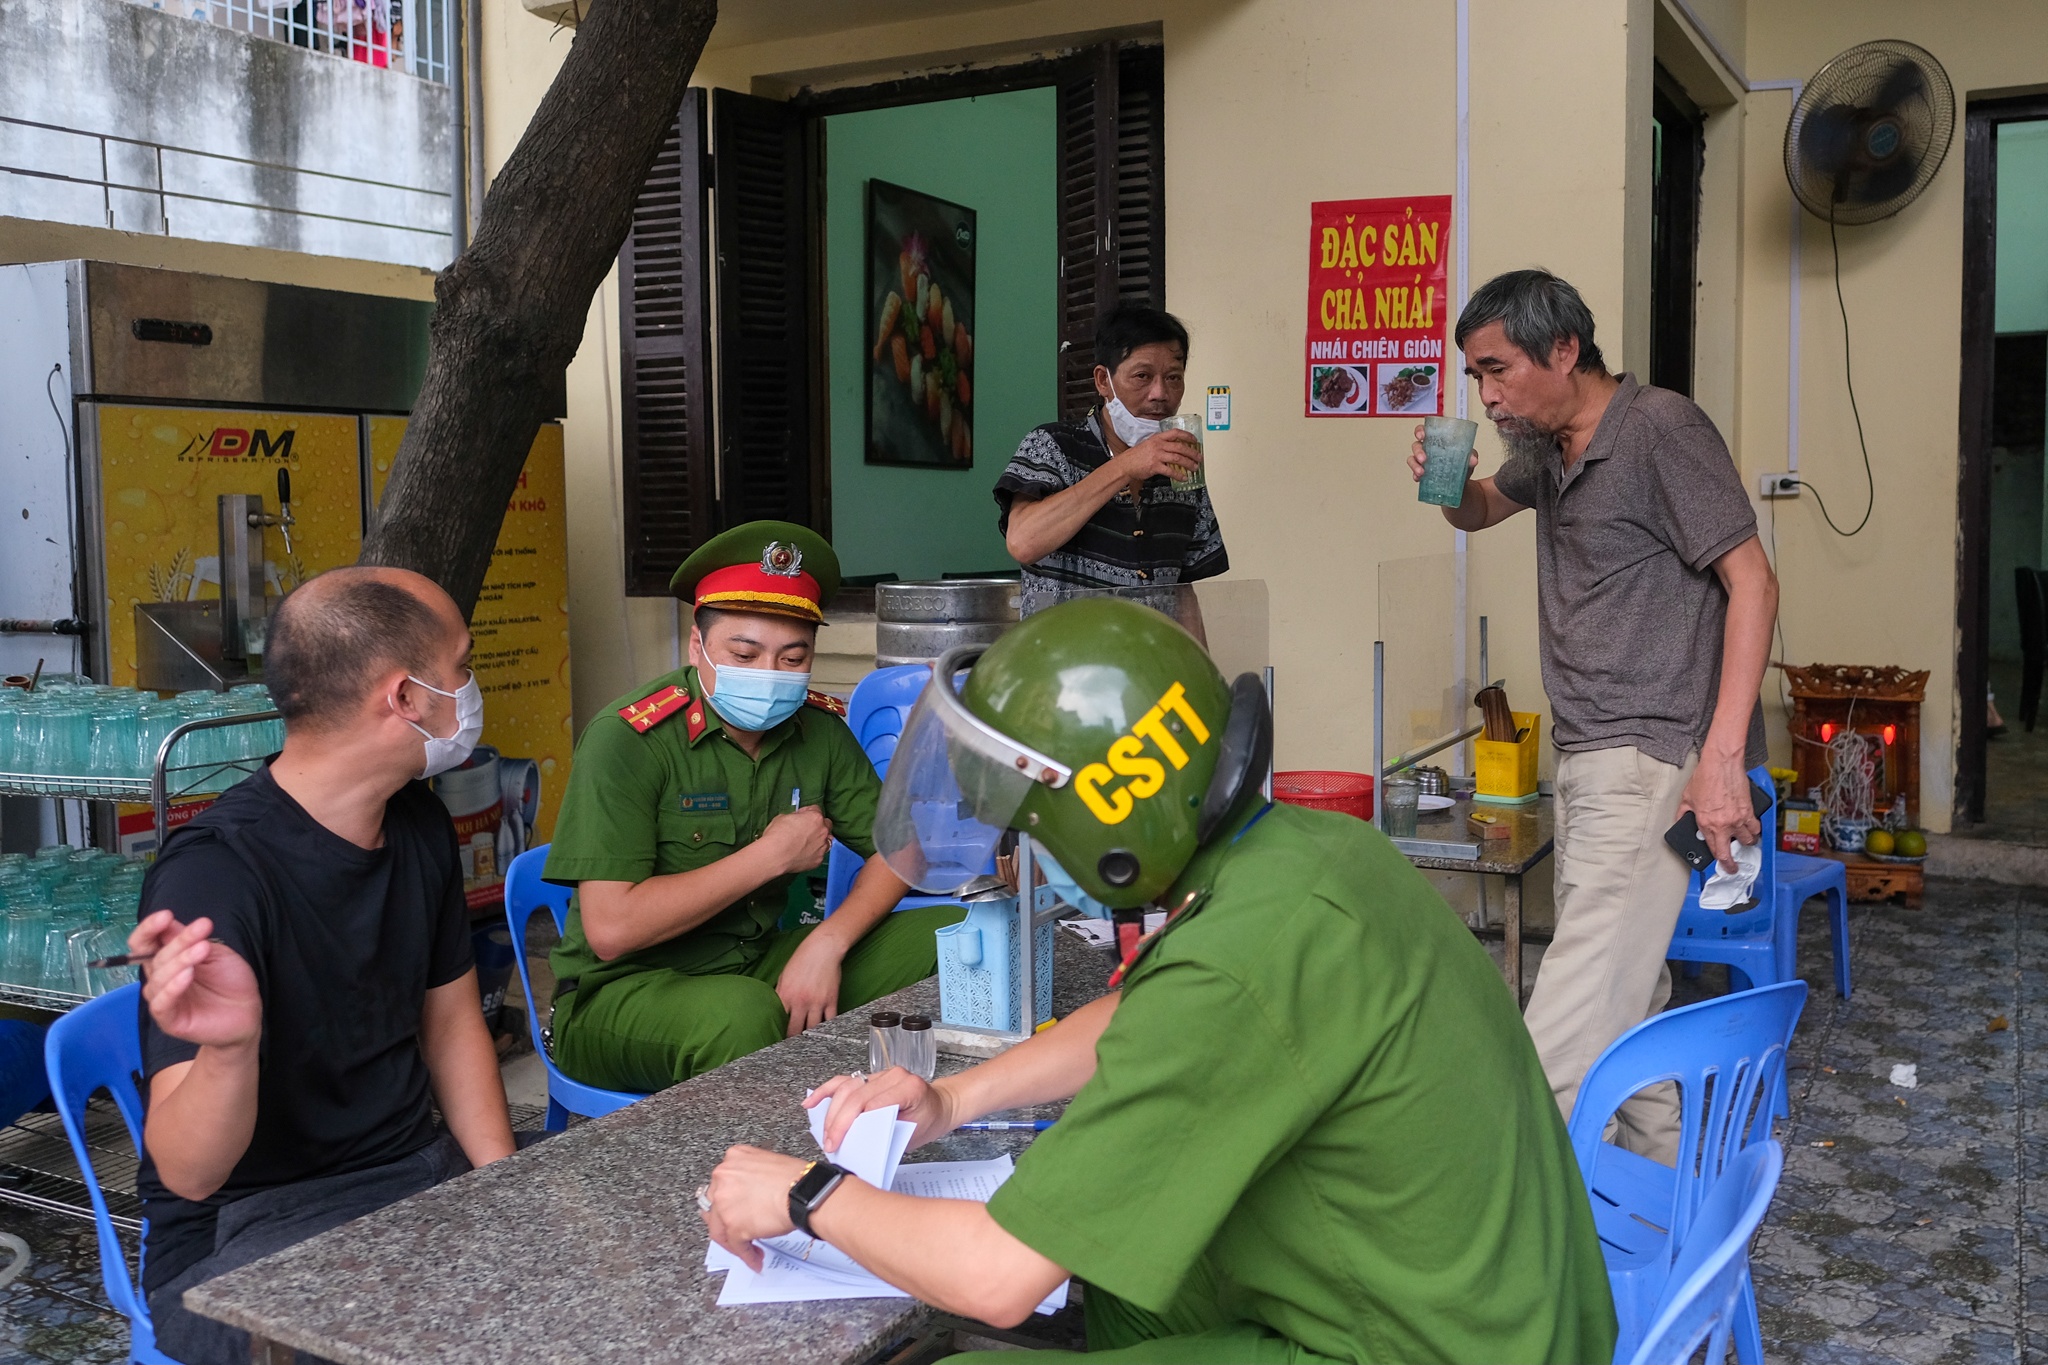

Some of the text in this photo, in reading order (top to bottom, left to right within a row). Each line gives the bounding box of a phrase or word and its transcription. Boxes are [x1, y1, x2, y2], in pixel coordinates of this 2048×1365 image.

[1320, 206, 1439, 278] ĐẶC SẢN
[1320, 271, 1435, 331] CHẢ NHÁI
[1310, 335, 1442, 359] NHÁI CHIÊN GIÒN
[177, 456, 289, 464] REFRIGERATION
[519, 497, 546, 512] KHÔ
[885, 595, 946, 612] HABECO
[1074, 681, 1211, 825] CSTT
